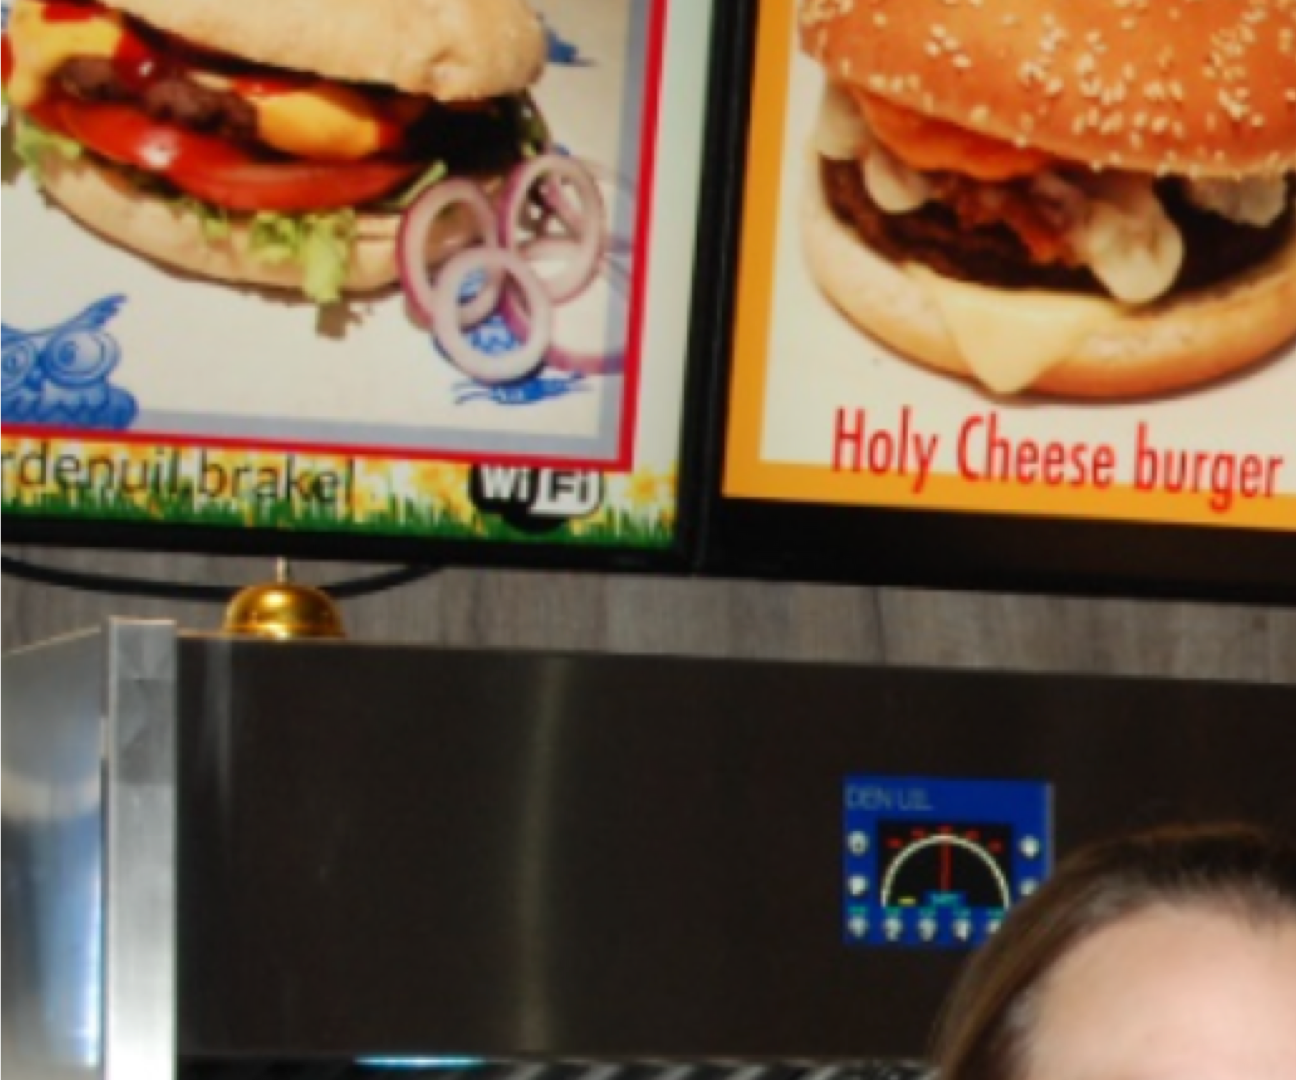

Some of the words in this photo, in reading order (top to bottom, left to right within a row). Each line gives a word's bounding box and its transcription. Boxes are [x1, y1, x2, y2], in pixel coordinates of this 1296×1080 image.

[831, 405, 940, 495] Holy
[955, 411, 1118, 489] Cheese
[1132, 419, 1285, 513] burger
